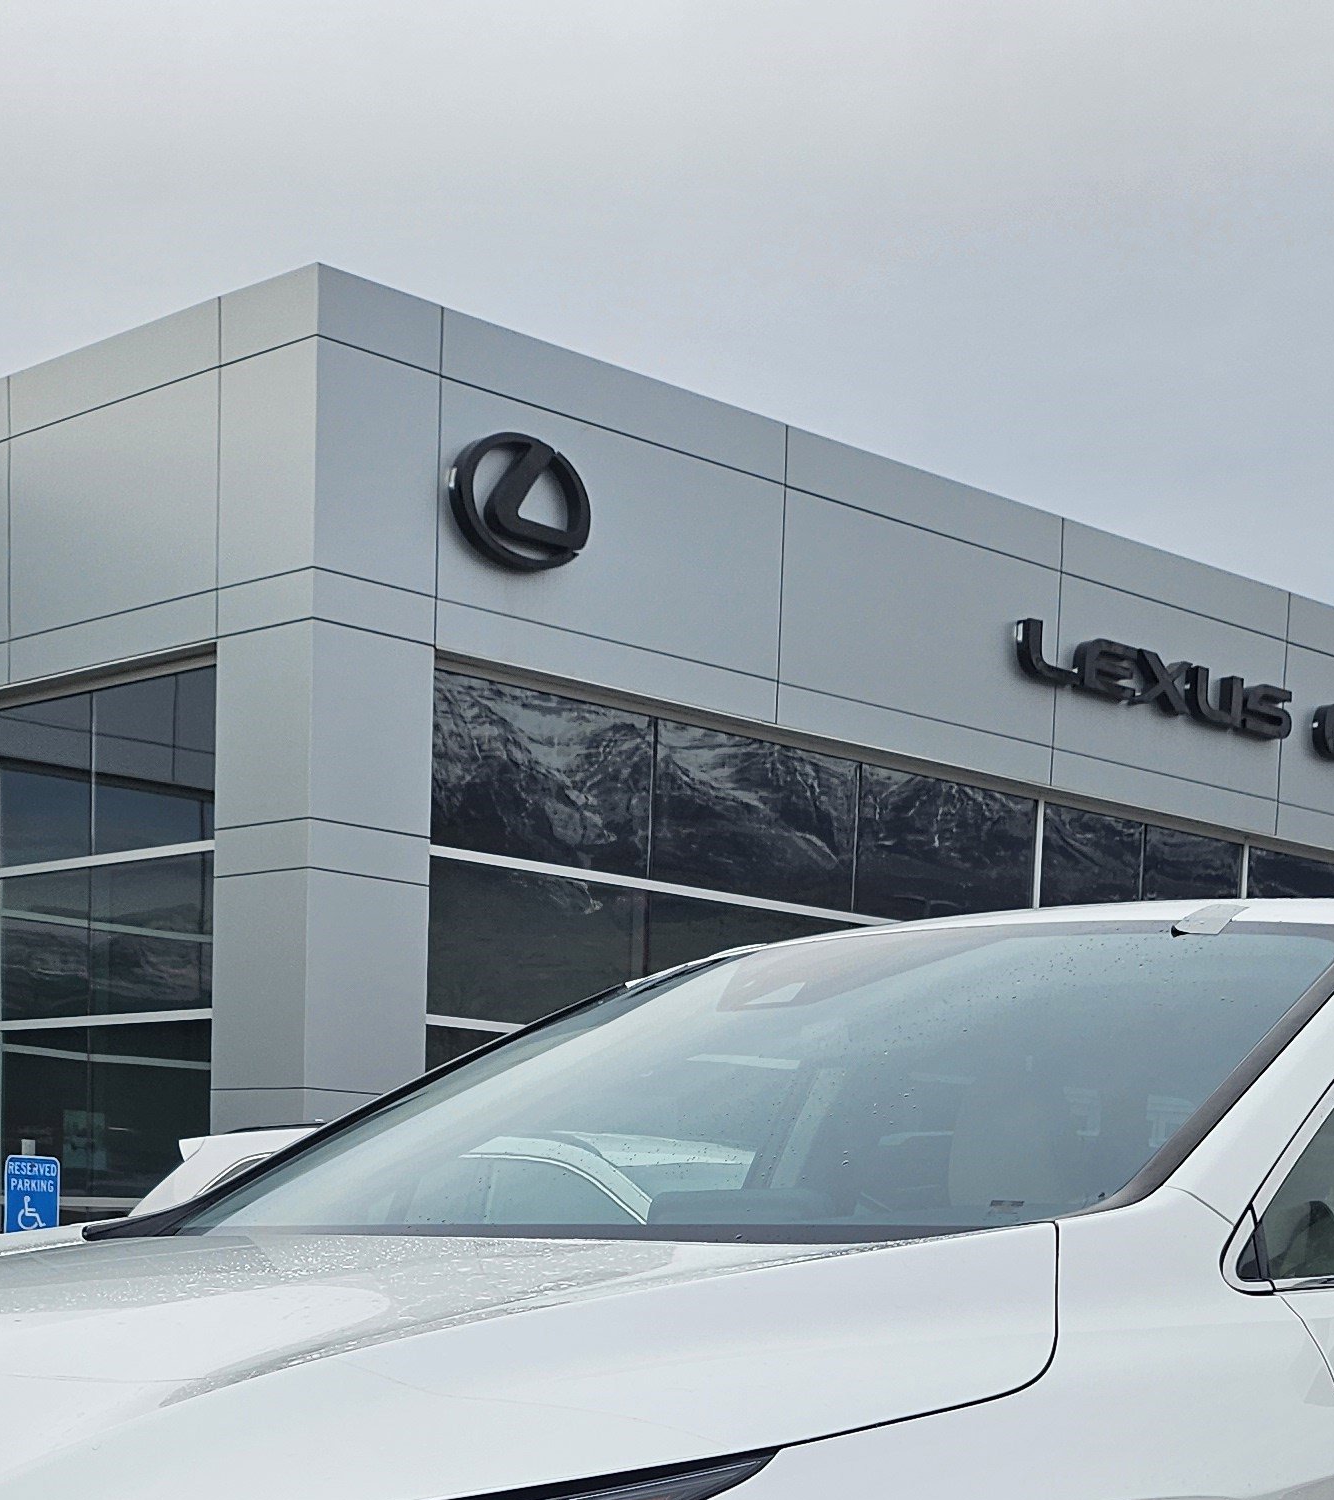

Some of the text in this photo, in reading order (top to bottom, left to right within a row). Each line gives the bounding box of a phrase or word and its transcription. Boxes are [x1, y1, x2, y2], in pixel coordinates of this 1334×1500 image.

[1015, 618, 1293, 739] LEXUS
[8, 1161, 58, 1177] RESERVED
[10, 1177, 55, 1193] PARKING
